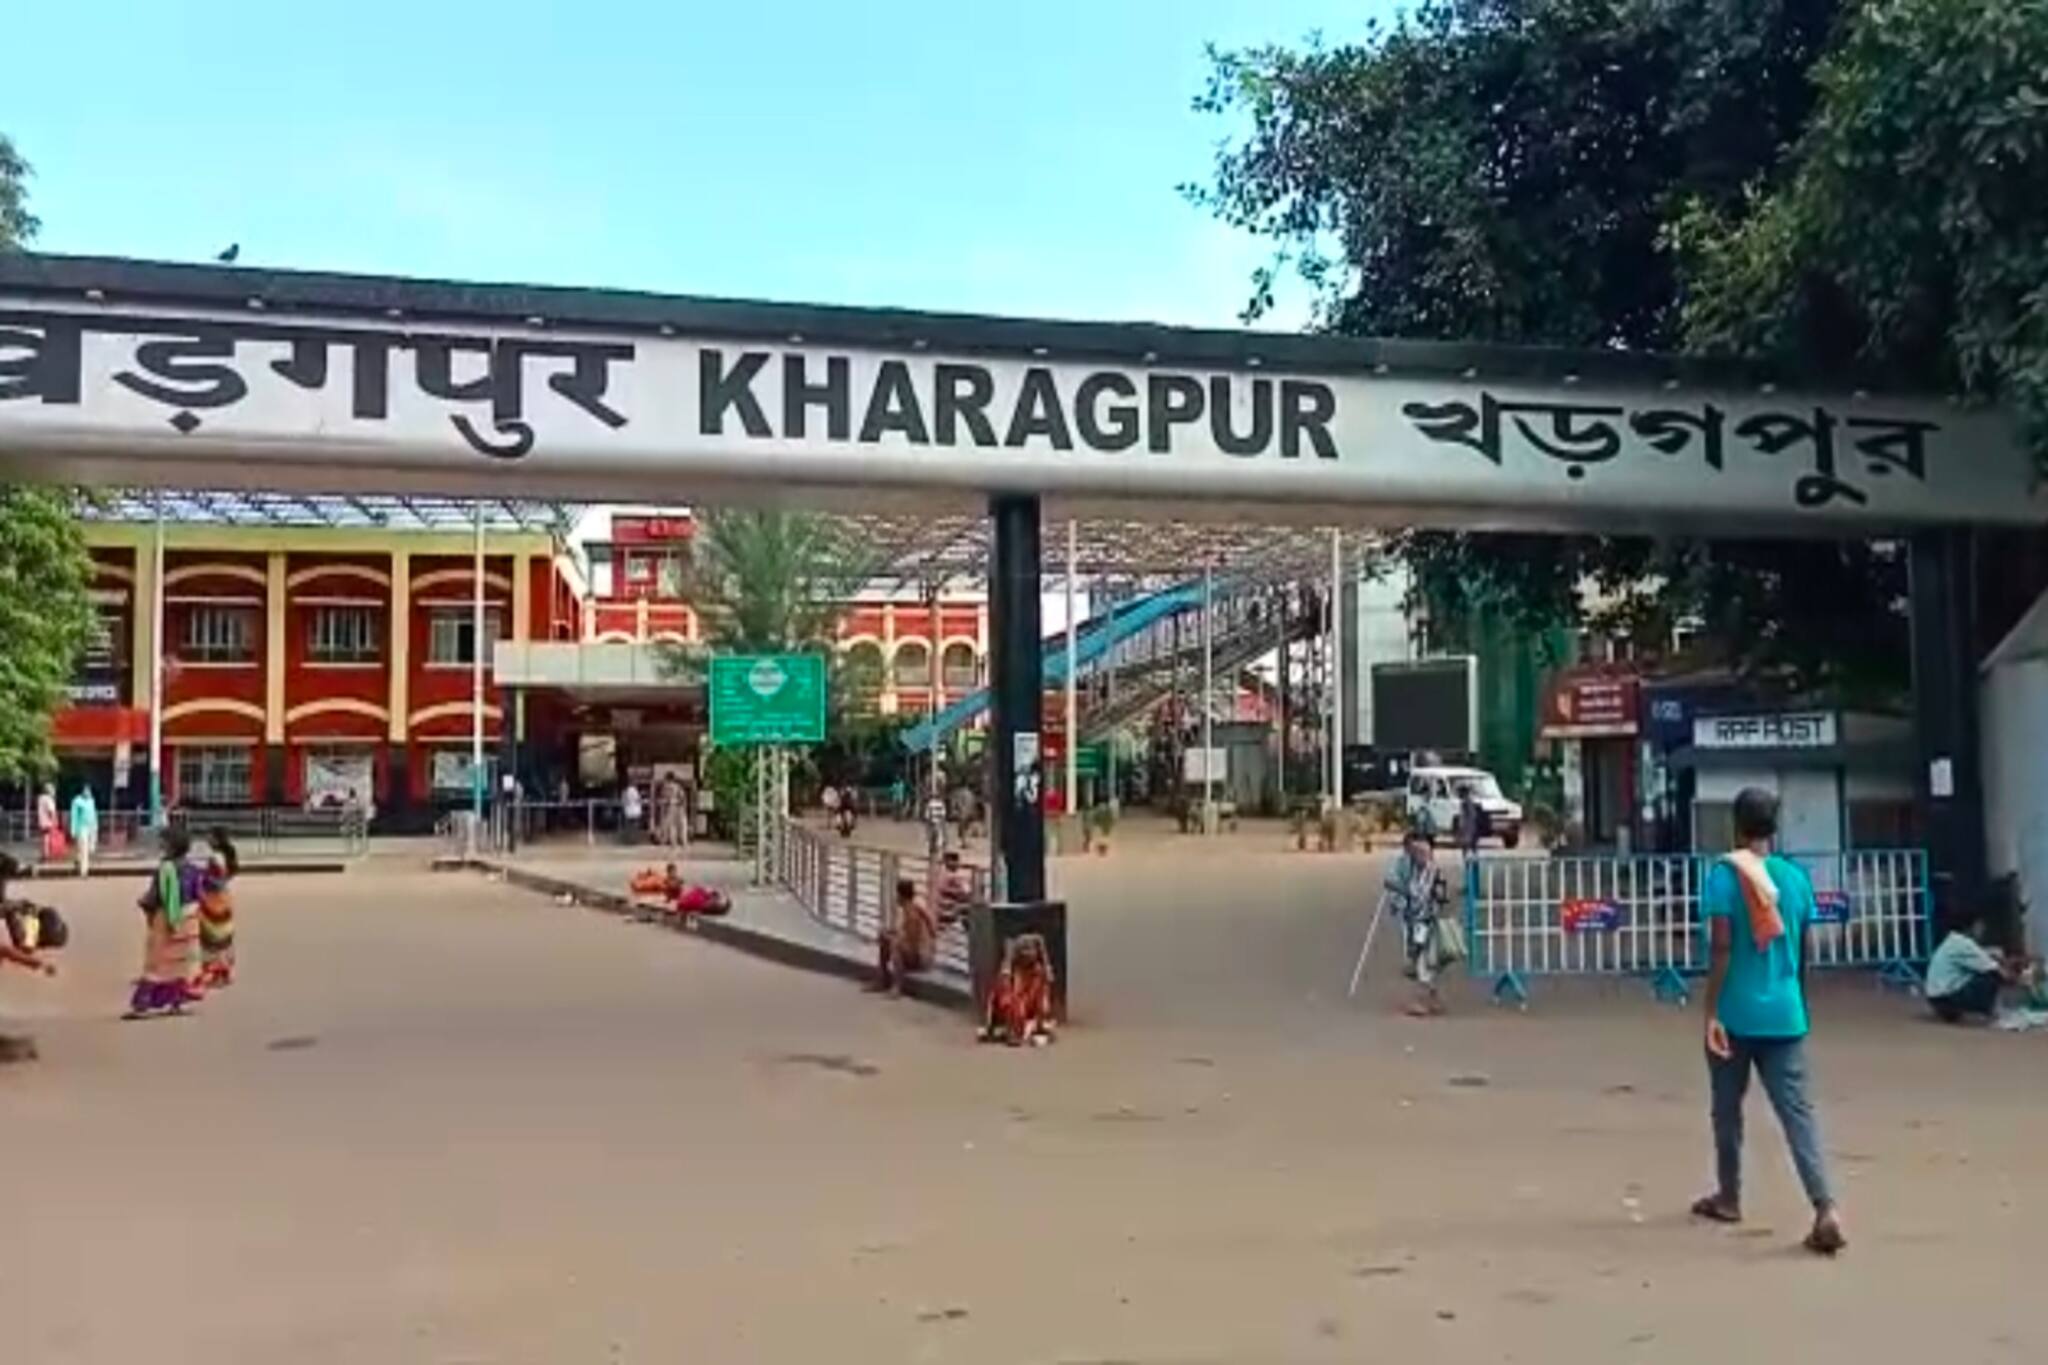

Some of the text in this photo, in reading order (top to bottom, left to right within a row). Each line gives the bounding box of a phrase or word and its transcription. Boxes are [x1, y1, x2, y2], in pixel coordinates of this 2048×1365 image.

[699, 348, 1339, 459] KHARAGPUR
[1402, 391, 1941, 506] খড়গপুর
[1716, 717, 1824, 740] RPF POST
